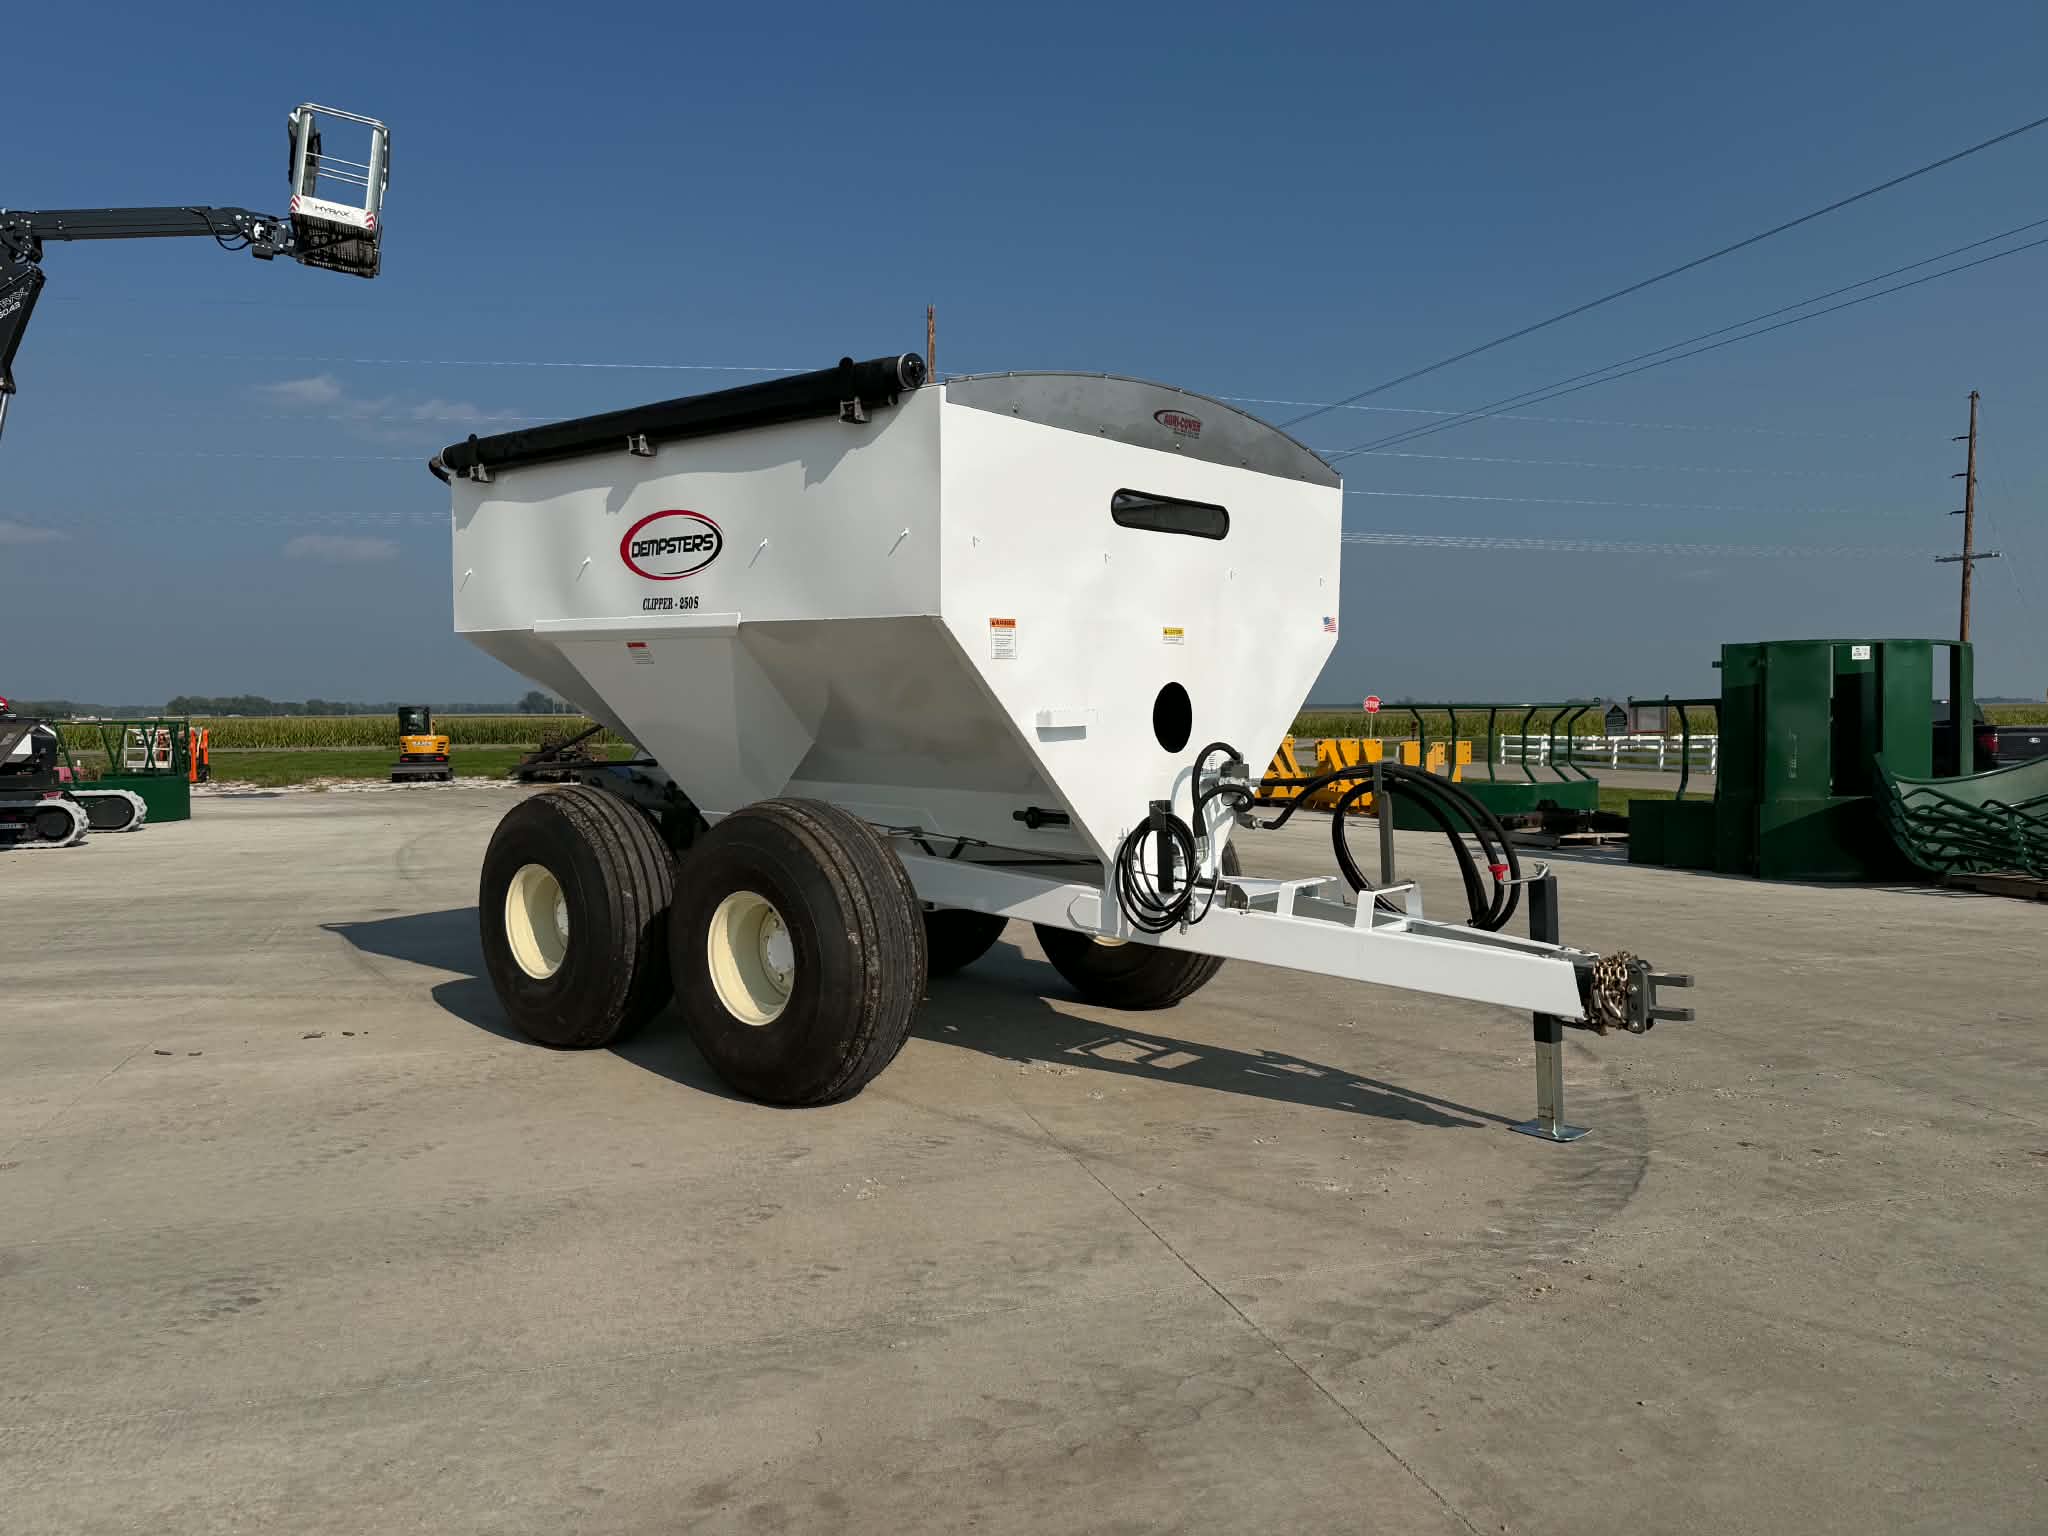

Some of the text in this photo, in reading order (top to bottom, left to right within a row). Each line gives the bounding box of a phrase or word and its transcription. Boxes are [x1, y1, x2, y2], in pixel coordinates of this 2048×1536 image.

[631, 533, 714, 559] DEMPSTERS
[642, 597, 673, 611] CLIPPER
[1365, 700, 1380, 708] STOP
